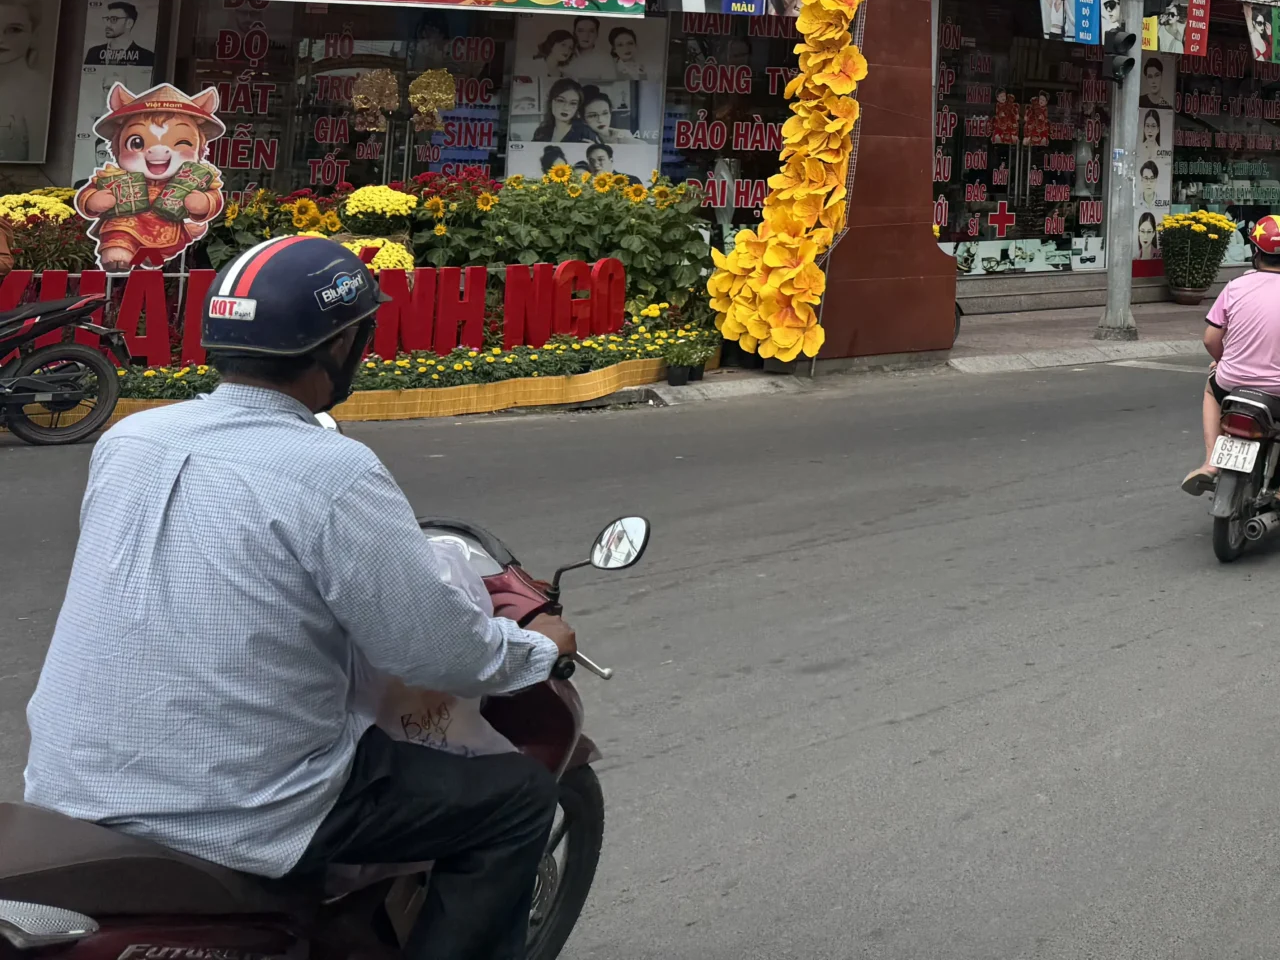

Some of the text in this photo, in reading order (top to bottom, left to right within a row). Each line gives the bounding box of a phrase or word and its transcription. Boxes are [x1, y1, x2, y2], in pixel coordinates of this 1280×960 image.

[731, 0, 755, 13] MÀU
[99, 49, 139, 61] ORIHANA
[216, 21, 270, 68] ĐỘ
[451, 36, 496, 62] CHO
[969, 50, 992, 74] LÀM
[684, 57, 752, 94] CÔNG
[314, 111, 350, 144] GIÁ
[442, 121, 493, 148] SINH
[674, 109, 727, 150] BẢO
[1086, 113, 1102, 148] ĐỘ
[415, 140, 441, 163] VÀO
[1043, 152, 1076, 173] LƯỢNG
[307, 148, 350, 186] TỐT
[1085, 154, 1101, 184] CÓ
[965, 180, 987, 202] BÁC
[1045, 180, 1071, 202] HÀNG
[1080, 197, 1104, 225] MÀU
[211, 299, 237, 317] KQT
[1220, 439, 1252, 456] 63-M1
[1216, 453, 1247, 470] 6711
